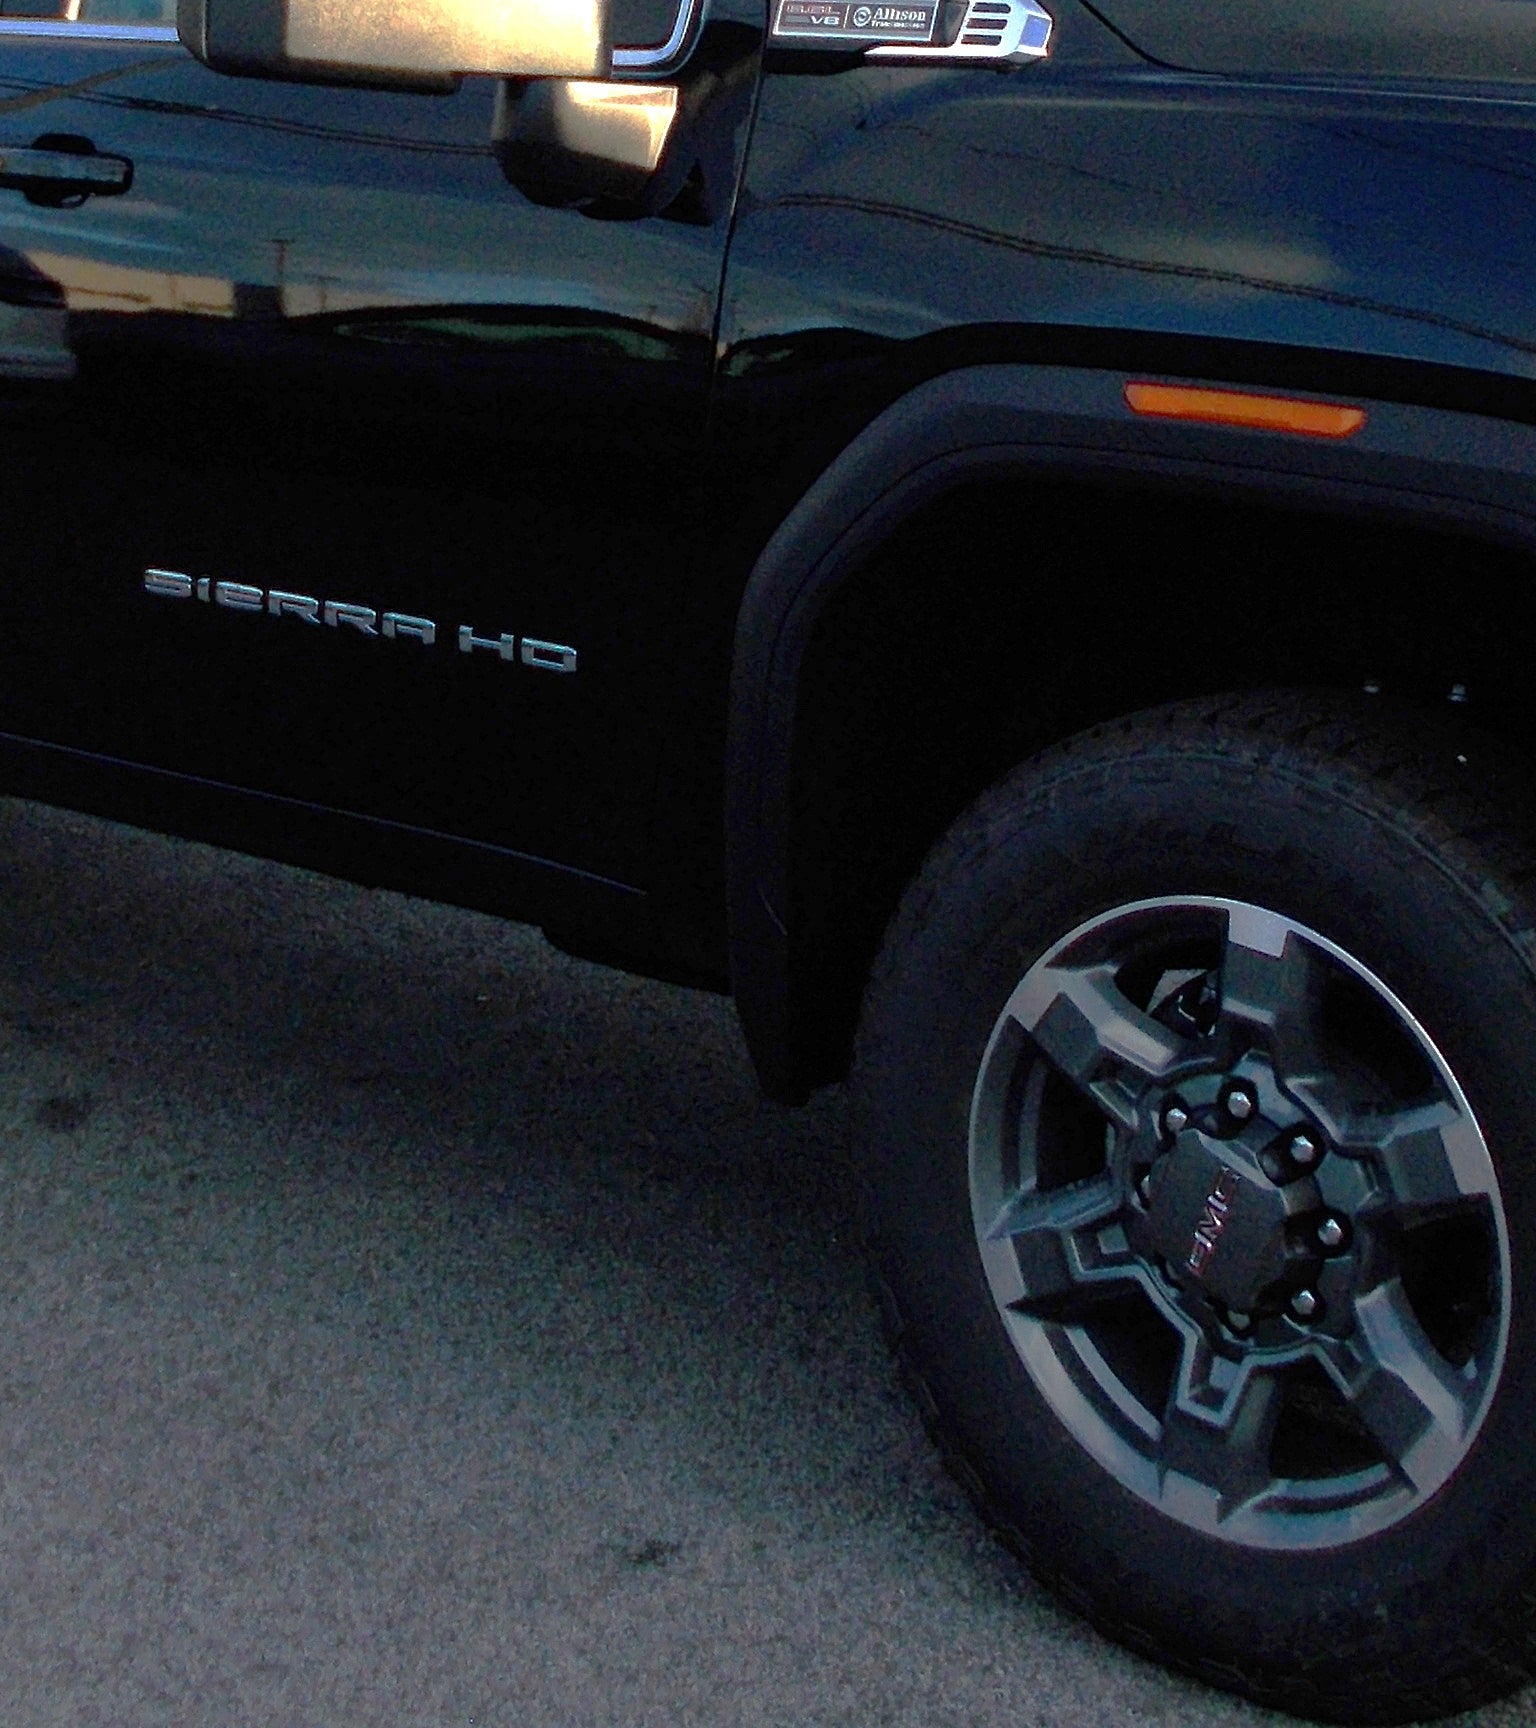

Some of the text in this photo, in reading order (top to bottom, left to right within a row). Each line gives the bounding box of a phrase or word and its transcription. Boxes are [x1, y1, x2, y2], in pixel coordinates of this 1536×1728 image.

[873, 7, 926, 21] Allison
[144, 568, 578, 672] SIERRA HD
